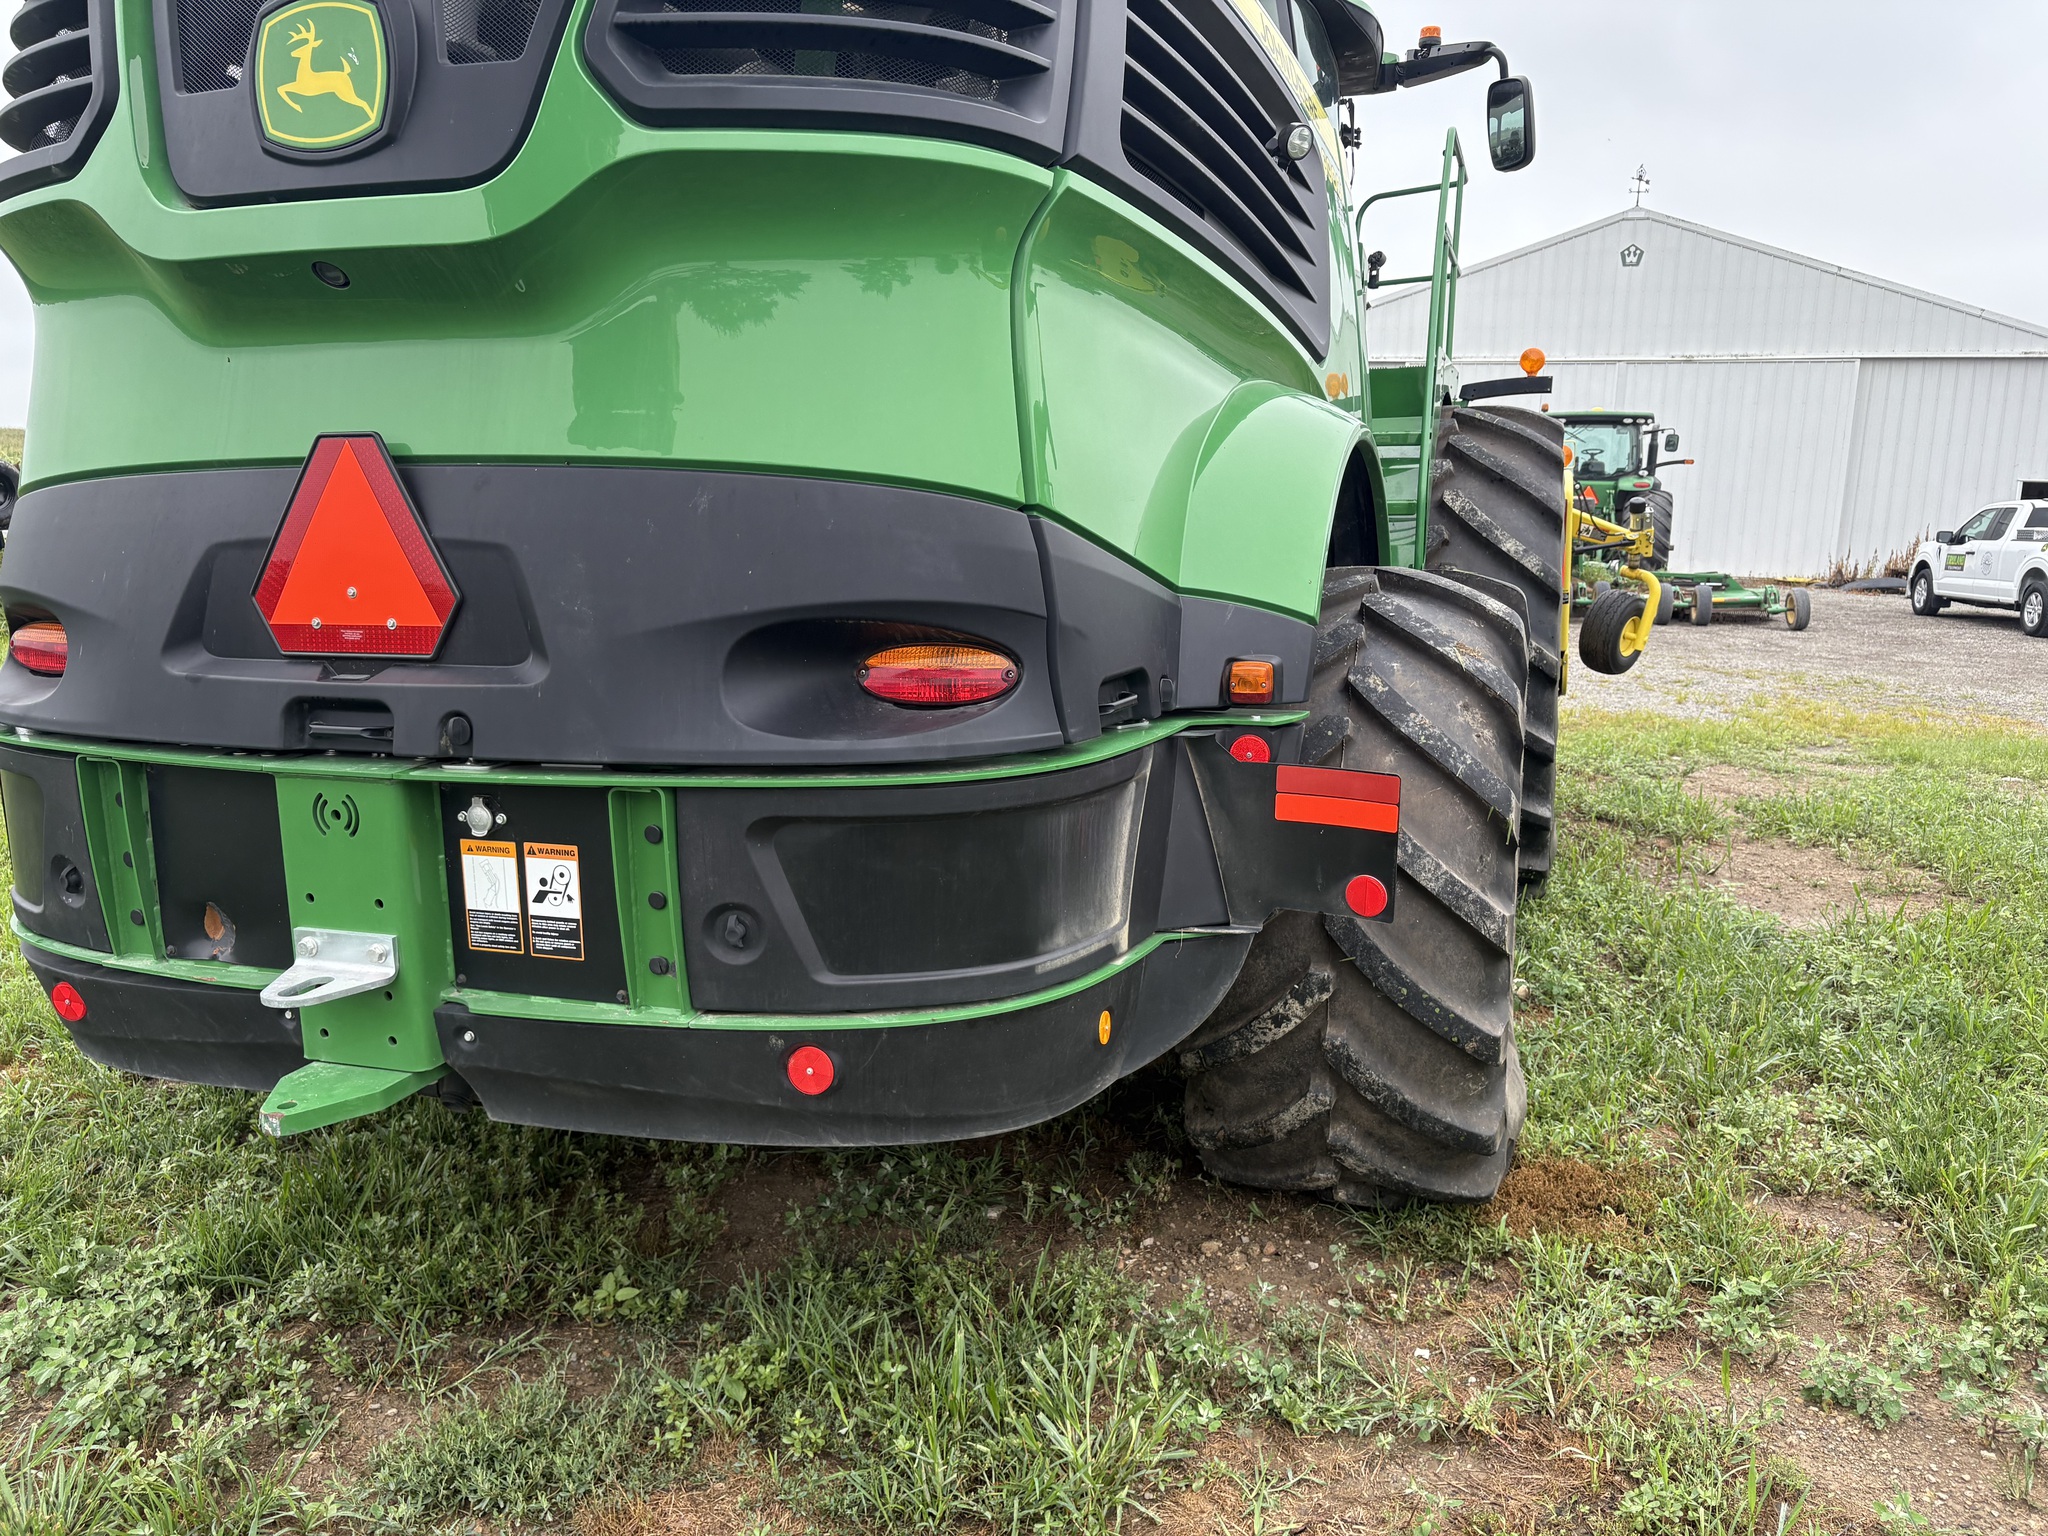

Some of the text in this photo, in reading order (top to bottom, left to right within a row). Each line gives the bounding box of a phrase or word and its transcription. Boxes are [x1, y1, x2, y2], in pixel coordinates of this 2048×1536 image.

[1260, 13, 1288, 71] JOHN
[475, 845, 510, 855] WARNING
[537, 847, 576, 857] WARNING
